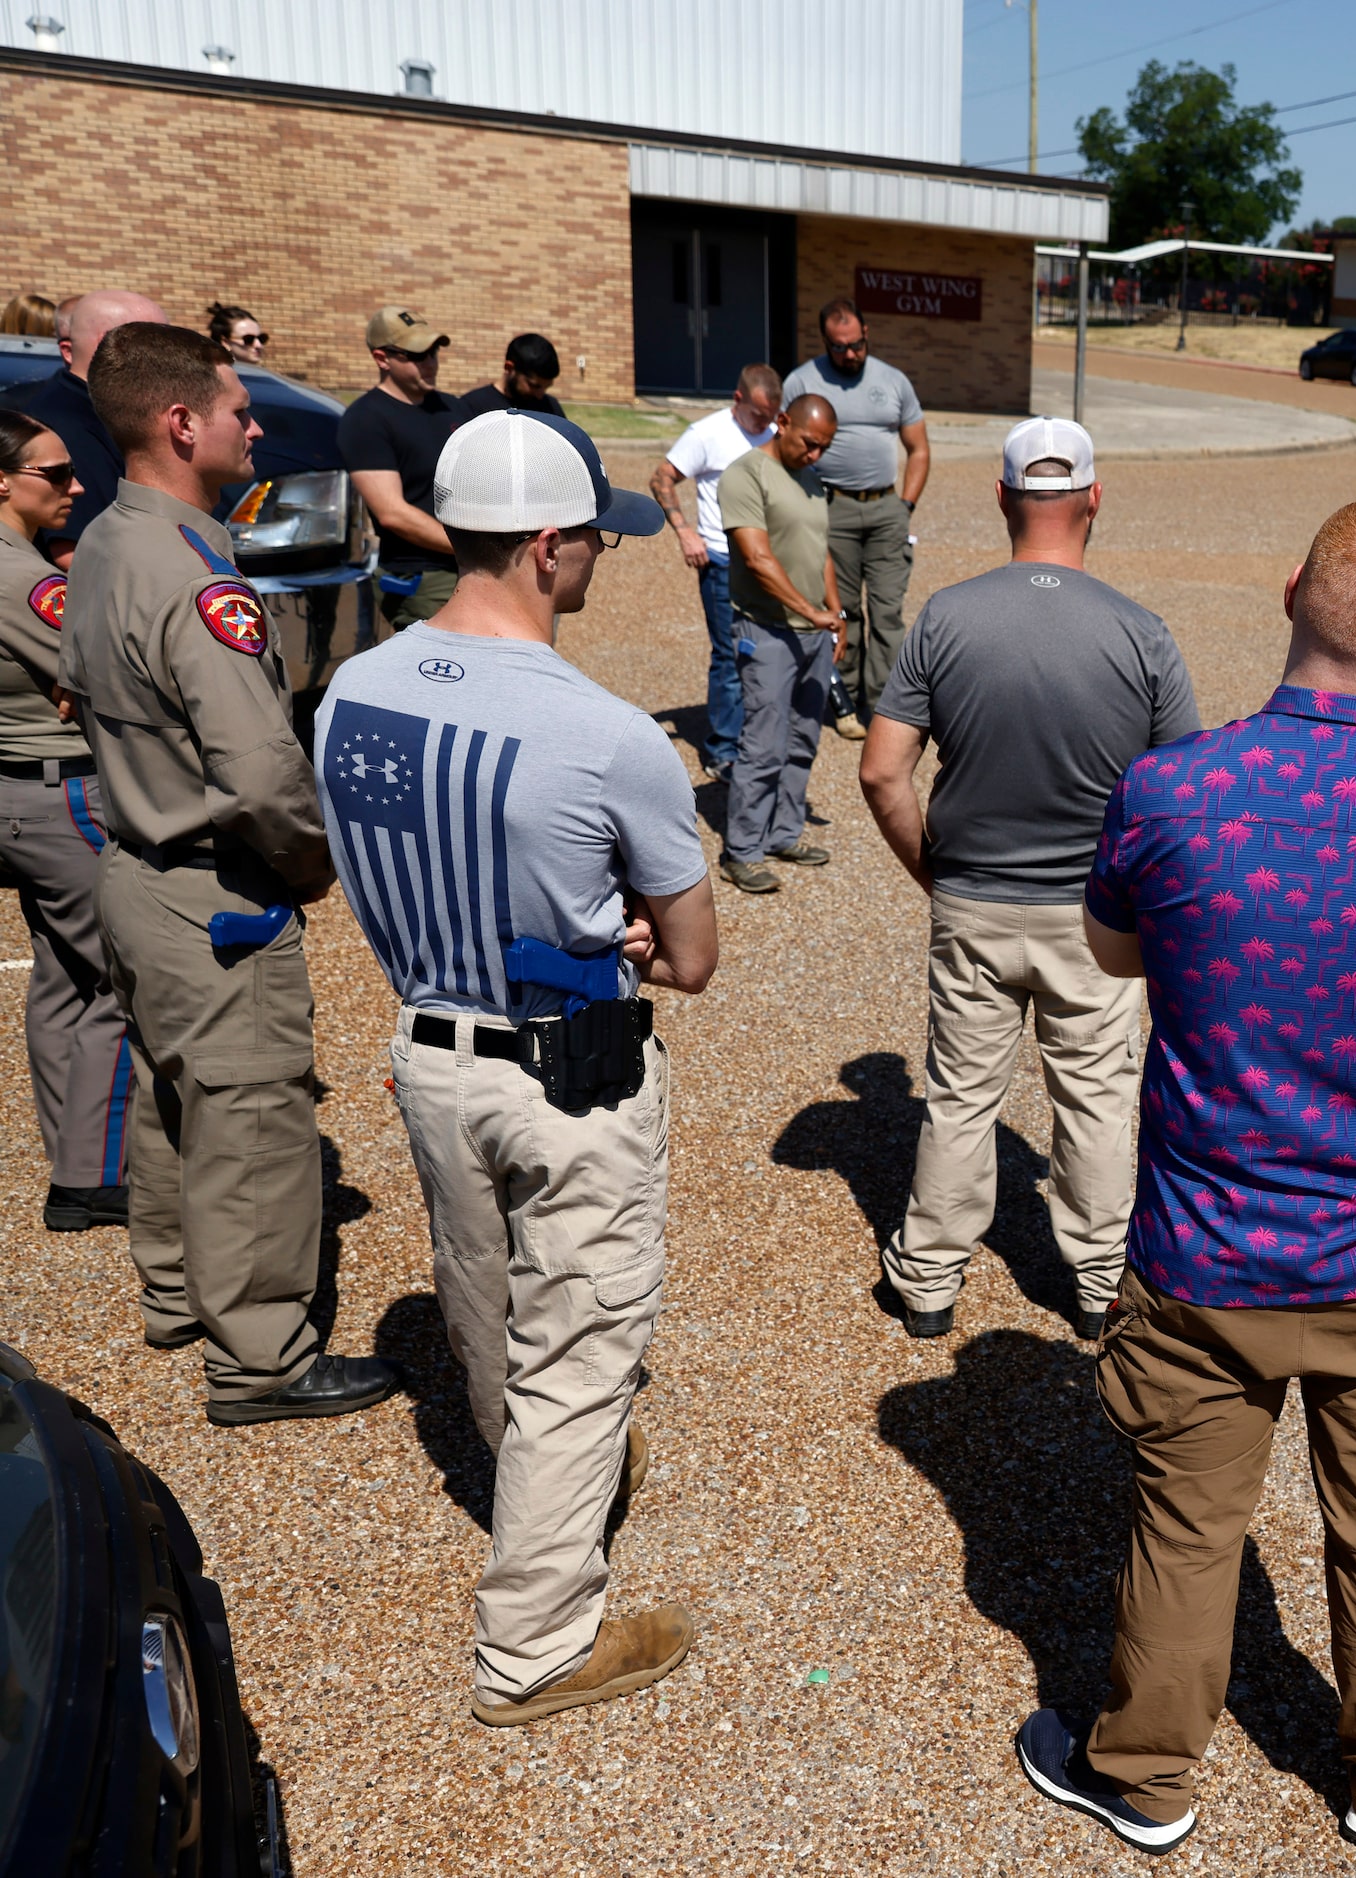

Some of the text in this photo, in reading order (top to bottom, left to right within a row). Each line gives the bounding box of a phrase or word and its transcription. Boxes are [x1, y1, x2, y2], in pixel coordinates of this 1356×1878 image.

[861, 271, 977, 298] WEST WING
[896, 295, 942, 315] GYM
